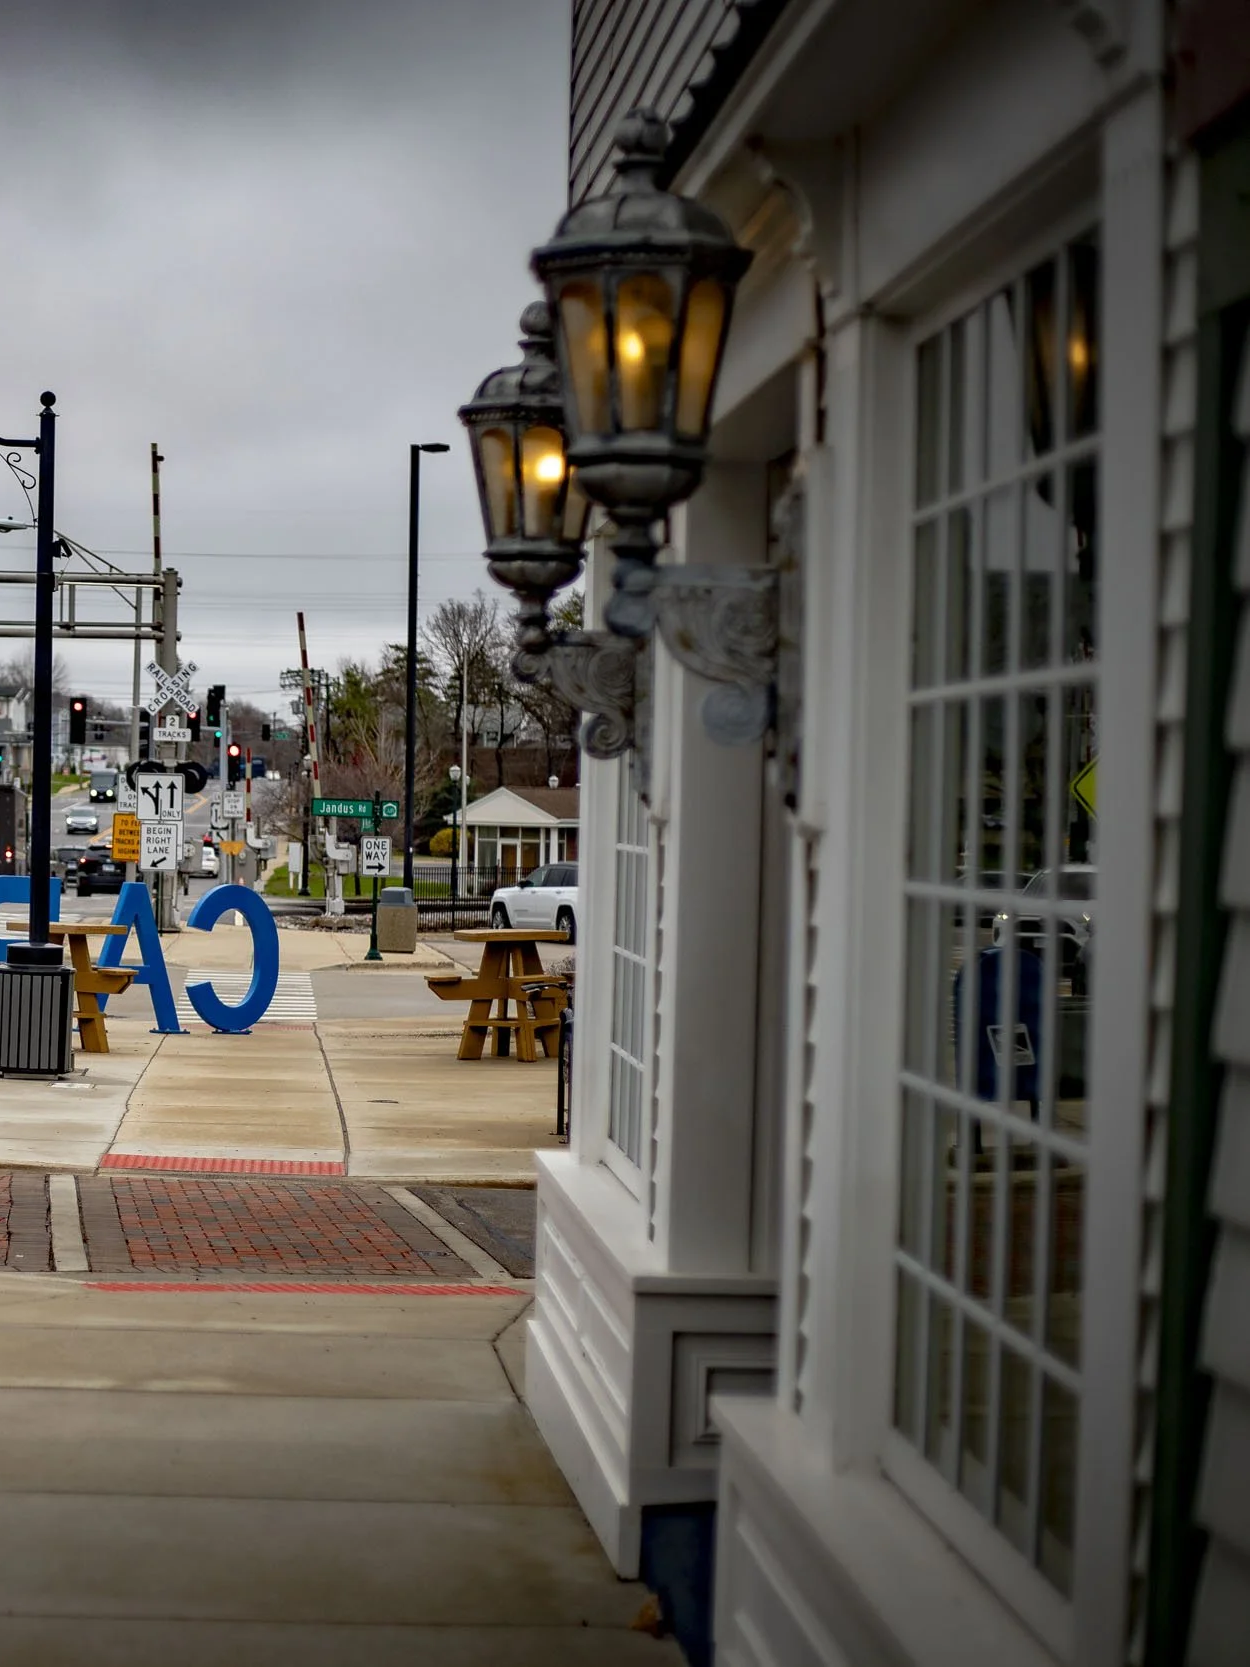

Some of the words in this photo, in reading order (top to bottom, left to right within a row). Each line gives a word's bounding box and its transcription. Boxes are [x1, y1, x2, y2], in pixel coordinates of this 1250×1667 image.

[147, 662, 196, 712] RAILROAD
[147, 663, 197, 712] CROSSING
[169, 717, 176, 726] 2
[158, 730, 187, 738] TRACKS
[320, 802, 354, 813] Jandus
[358, 804, 367, 813] Rd
[162, 810, 181, 818] ONLY
[146, 827, 172, 835] BEGIN
[147, 846, 170, 854] LANE
[365, 841, 387, 850] ONE
[365, 851, 387, 860] WAY
